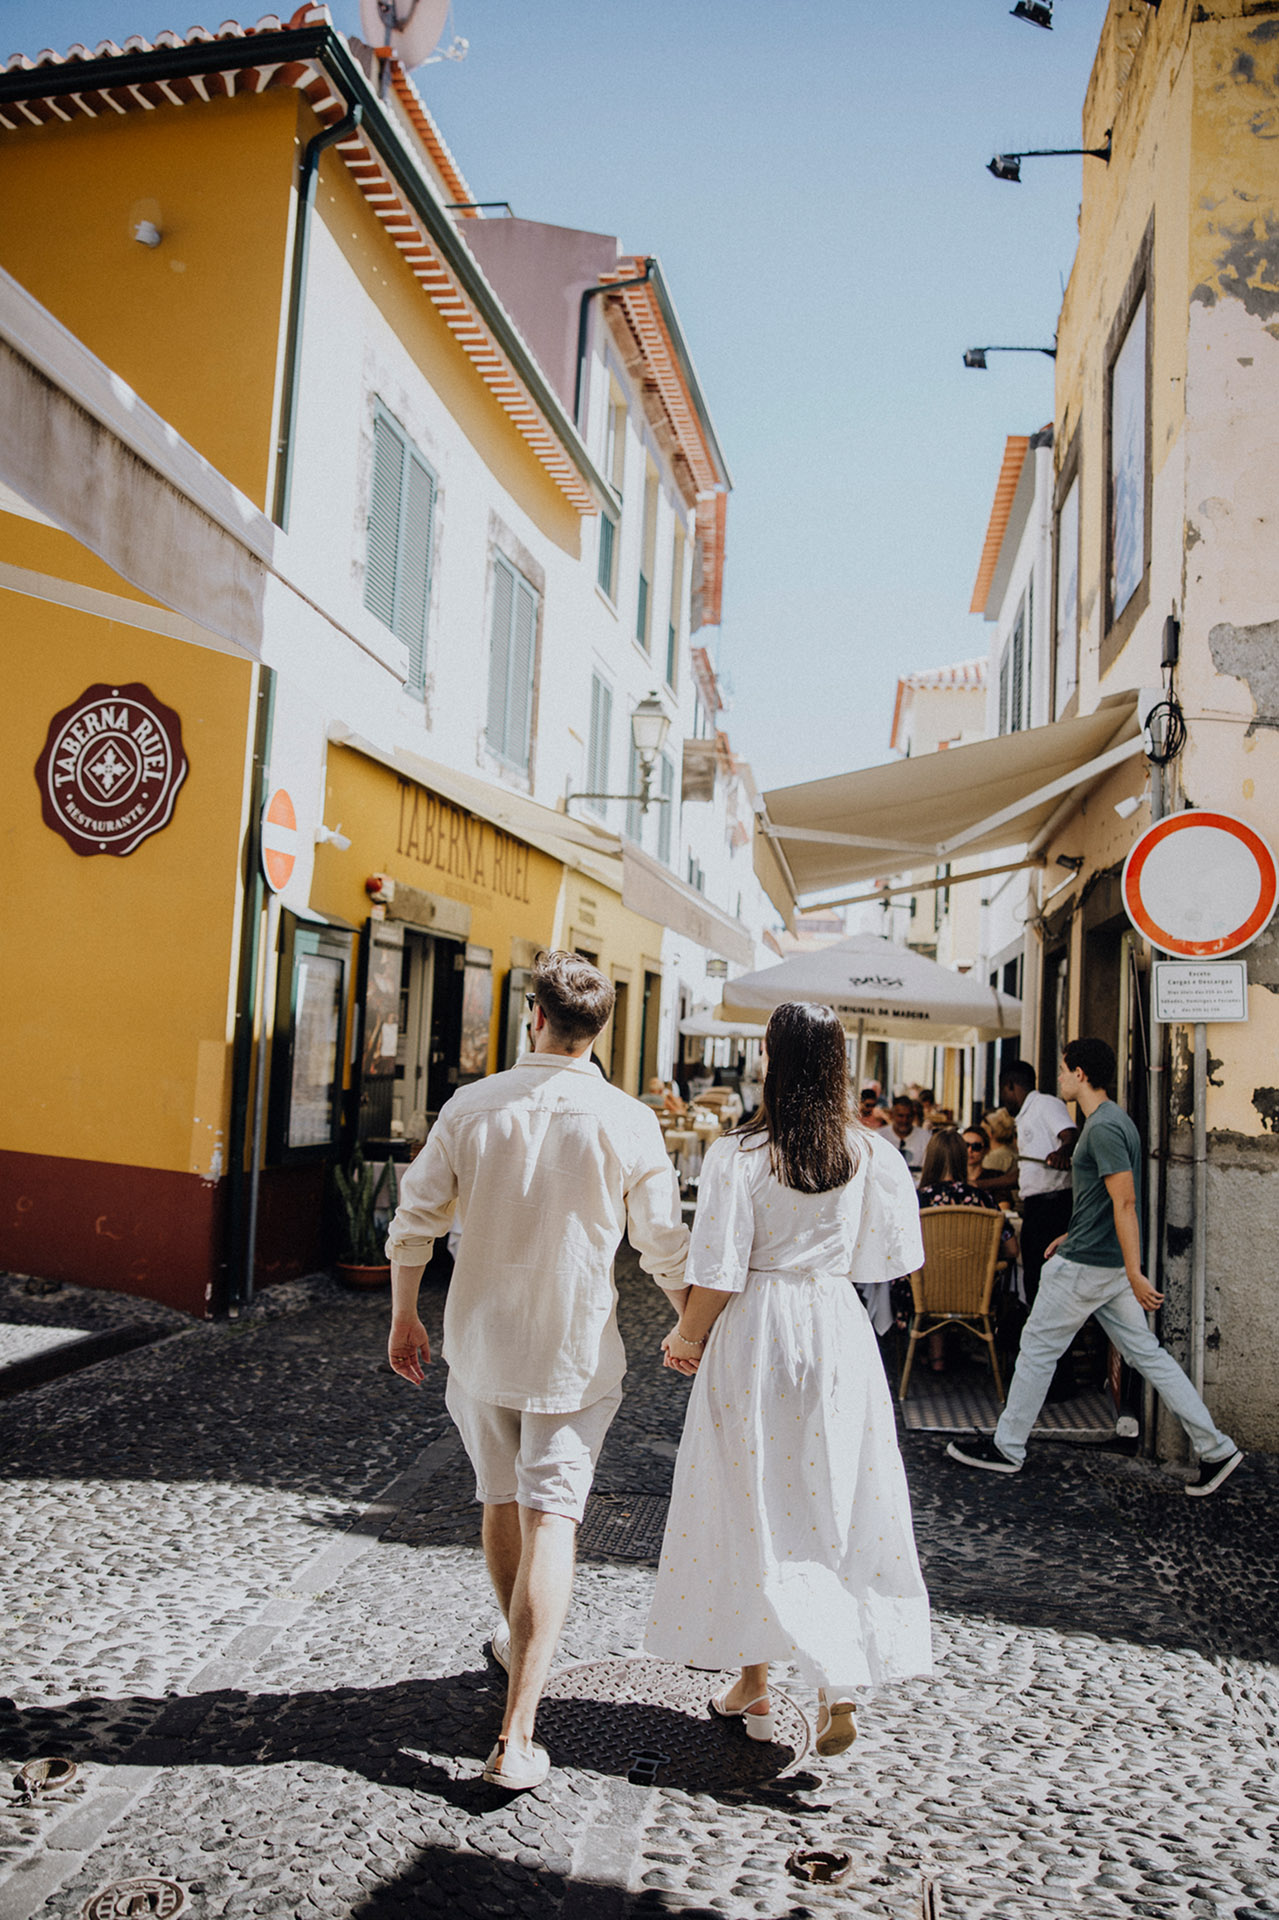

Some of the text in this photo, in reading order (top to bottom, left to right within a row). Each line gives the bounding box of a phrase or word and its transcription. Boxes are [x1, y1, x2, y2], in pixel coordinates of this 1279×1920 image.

[55, 705, 166, 788] TABERNA RUEL
[64, 801, 146, 832] RESTAURANTE
[397, 777, 531, 905] TABERNA RUEL
[838, 1005, 875, 1015] ORIGINAL
[878, 1007, 889, 1016] DA
[892, 1009, 930, 1020] MADEIRA
